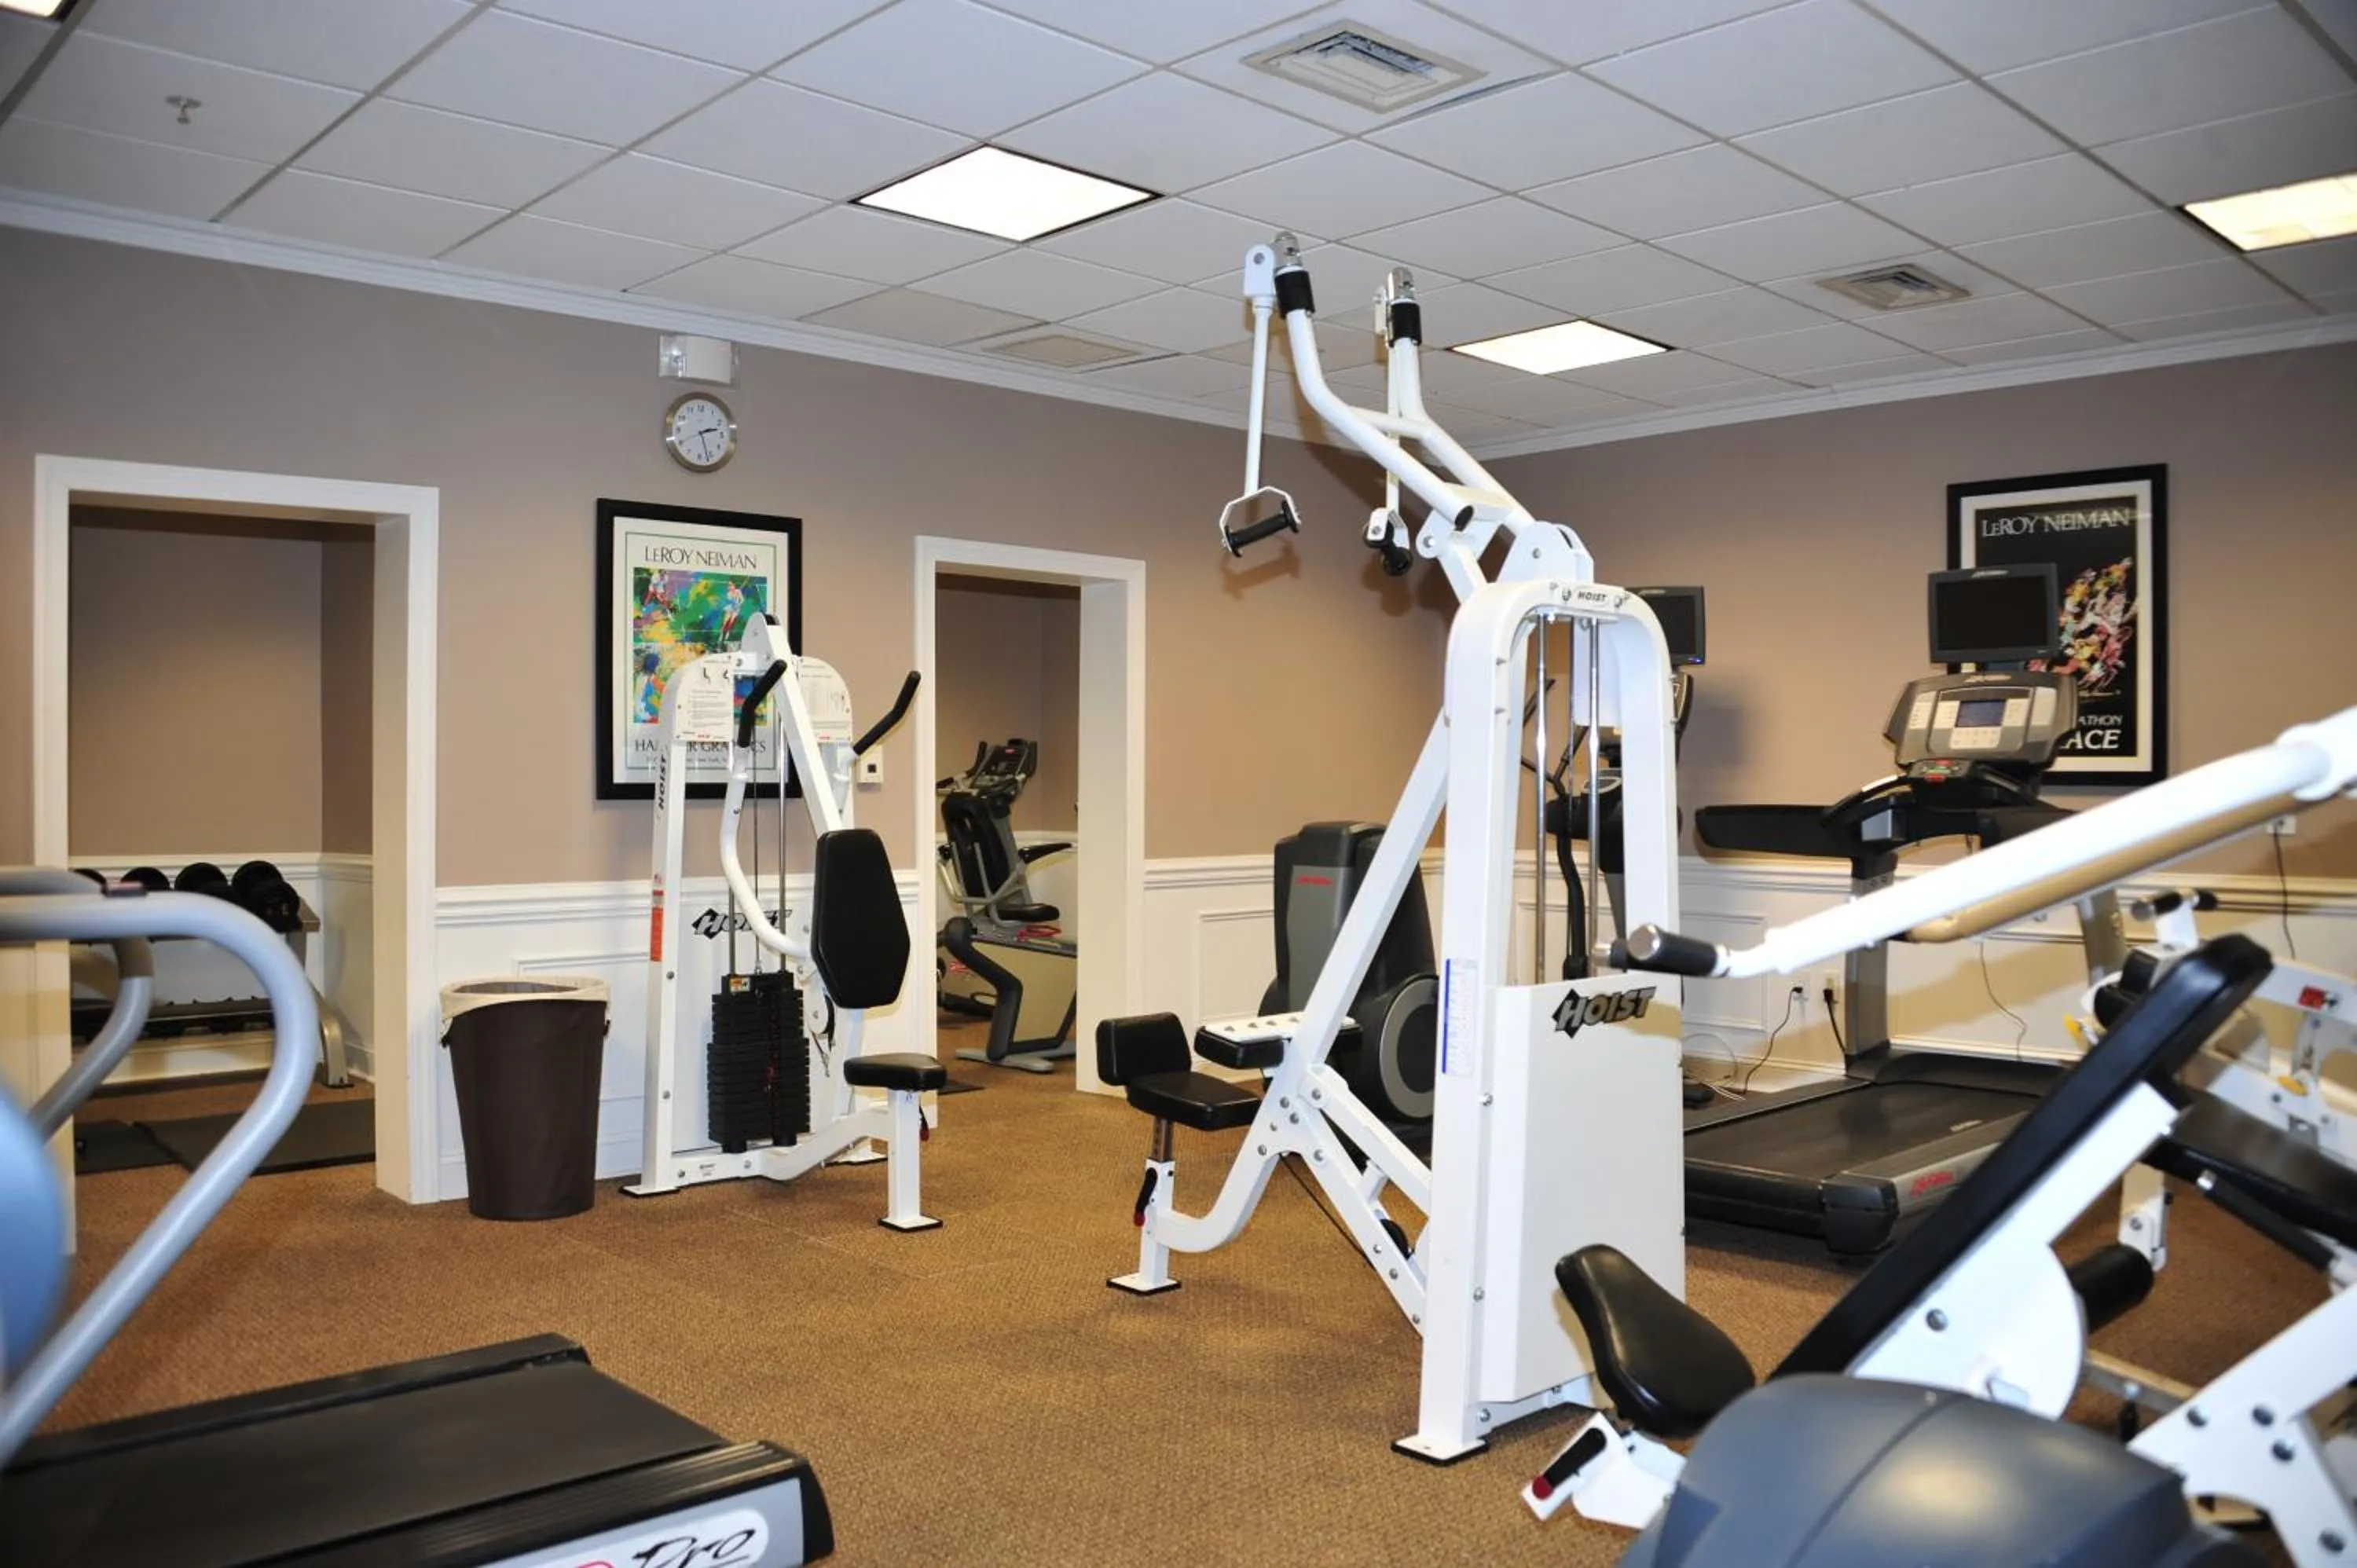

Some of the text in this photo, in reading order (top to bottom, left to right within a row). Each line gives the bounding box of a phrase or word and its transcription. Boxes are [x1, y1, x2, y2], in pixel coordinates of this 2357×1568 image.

[2044, 508, 2131, 533] NEIMAN
[696, 551, 757, 570] NEIMAN
[1577, 590, 1607, 601] HOIST
[2077, 714, 2124, 726] ATHON
[2061, 729, 2123, 749] ACE
[658, 753, 667, 811] HOIST
[1553, 986, 1657, 1034] HOIST
